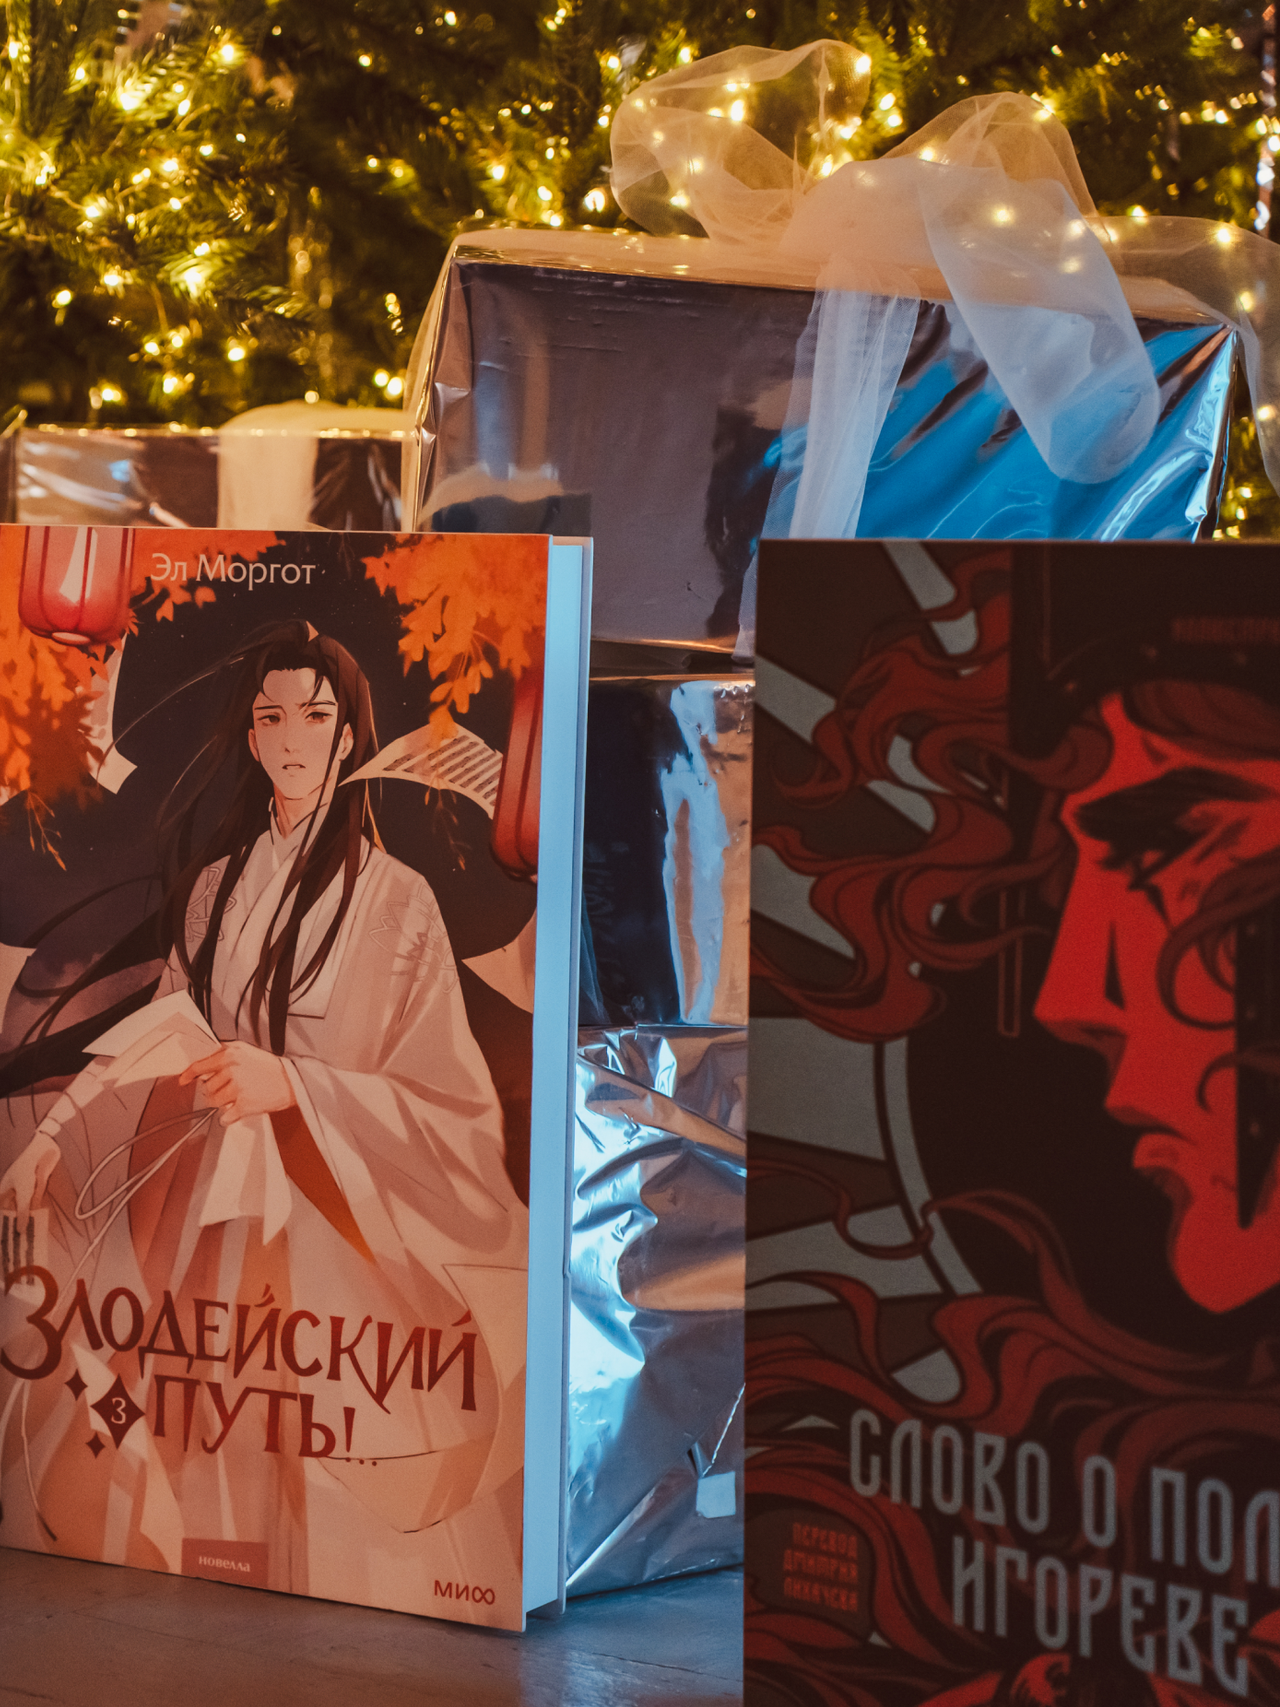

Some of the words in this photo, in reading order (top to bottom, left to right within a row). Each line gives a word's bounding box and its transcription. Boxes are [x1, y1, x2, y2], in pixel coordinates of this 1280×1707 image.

[150, 552, 188, 583] Эл
[196, 554, 317, 590] Моргот
[0, 1265, 477, 1414] ЗЛОДЕЙСКИЙ
[849, 1409, 1051, 1534] СЛОВО
[1082, 1455, 1117, 1549] О
[198, 1553, 251, 1573] новелла
[952, 1535, 1249, 1697] ИГОРЕВЕ
